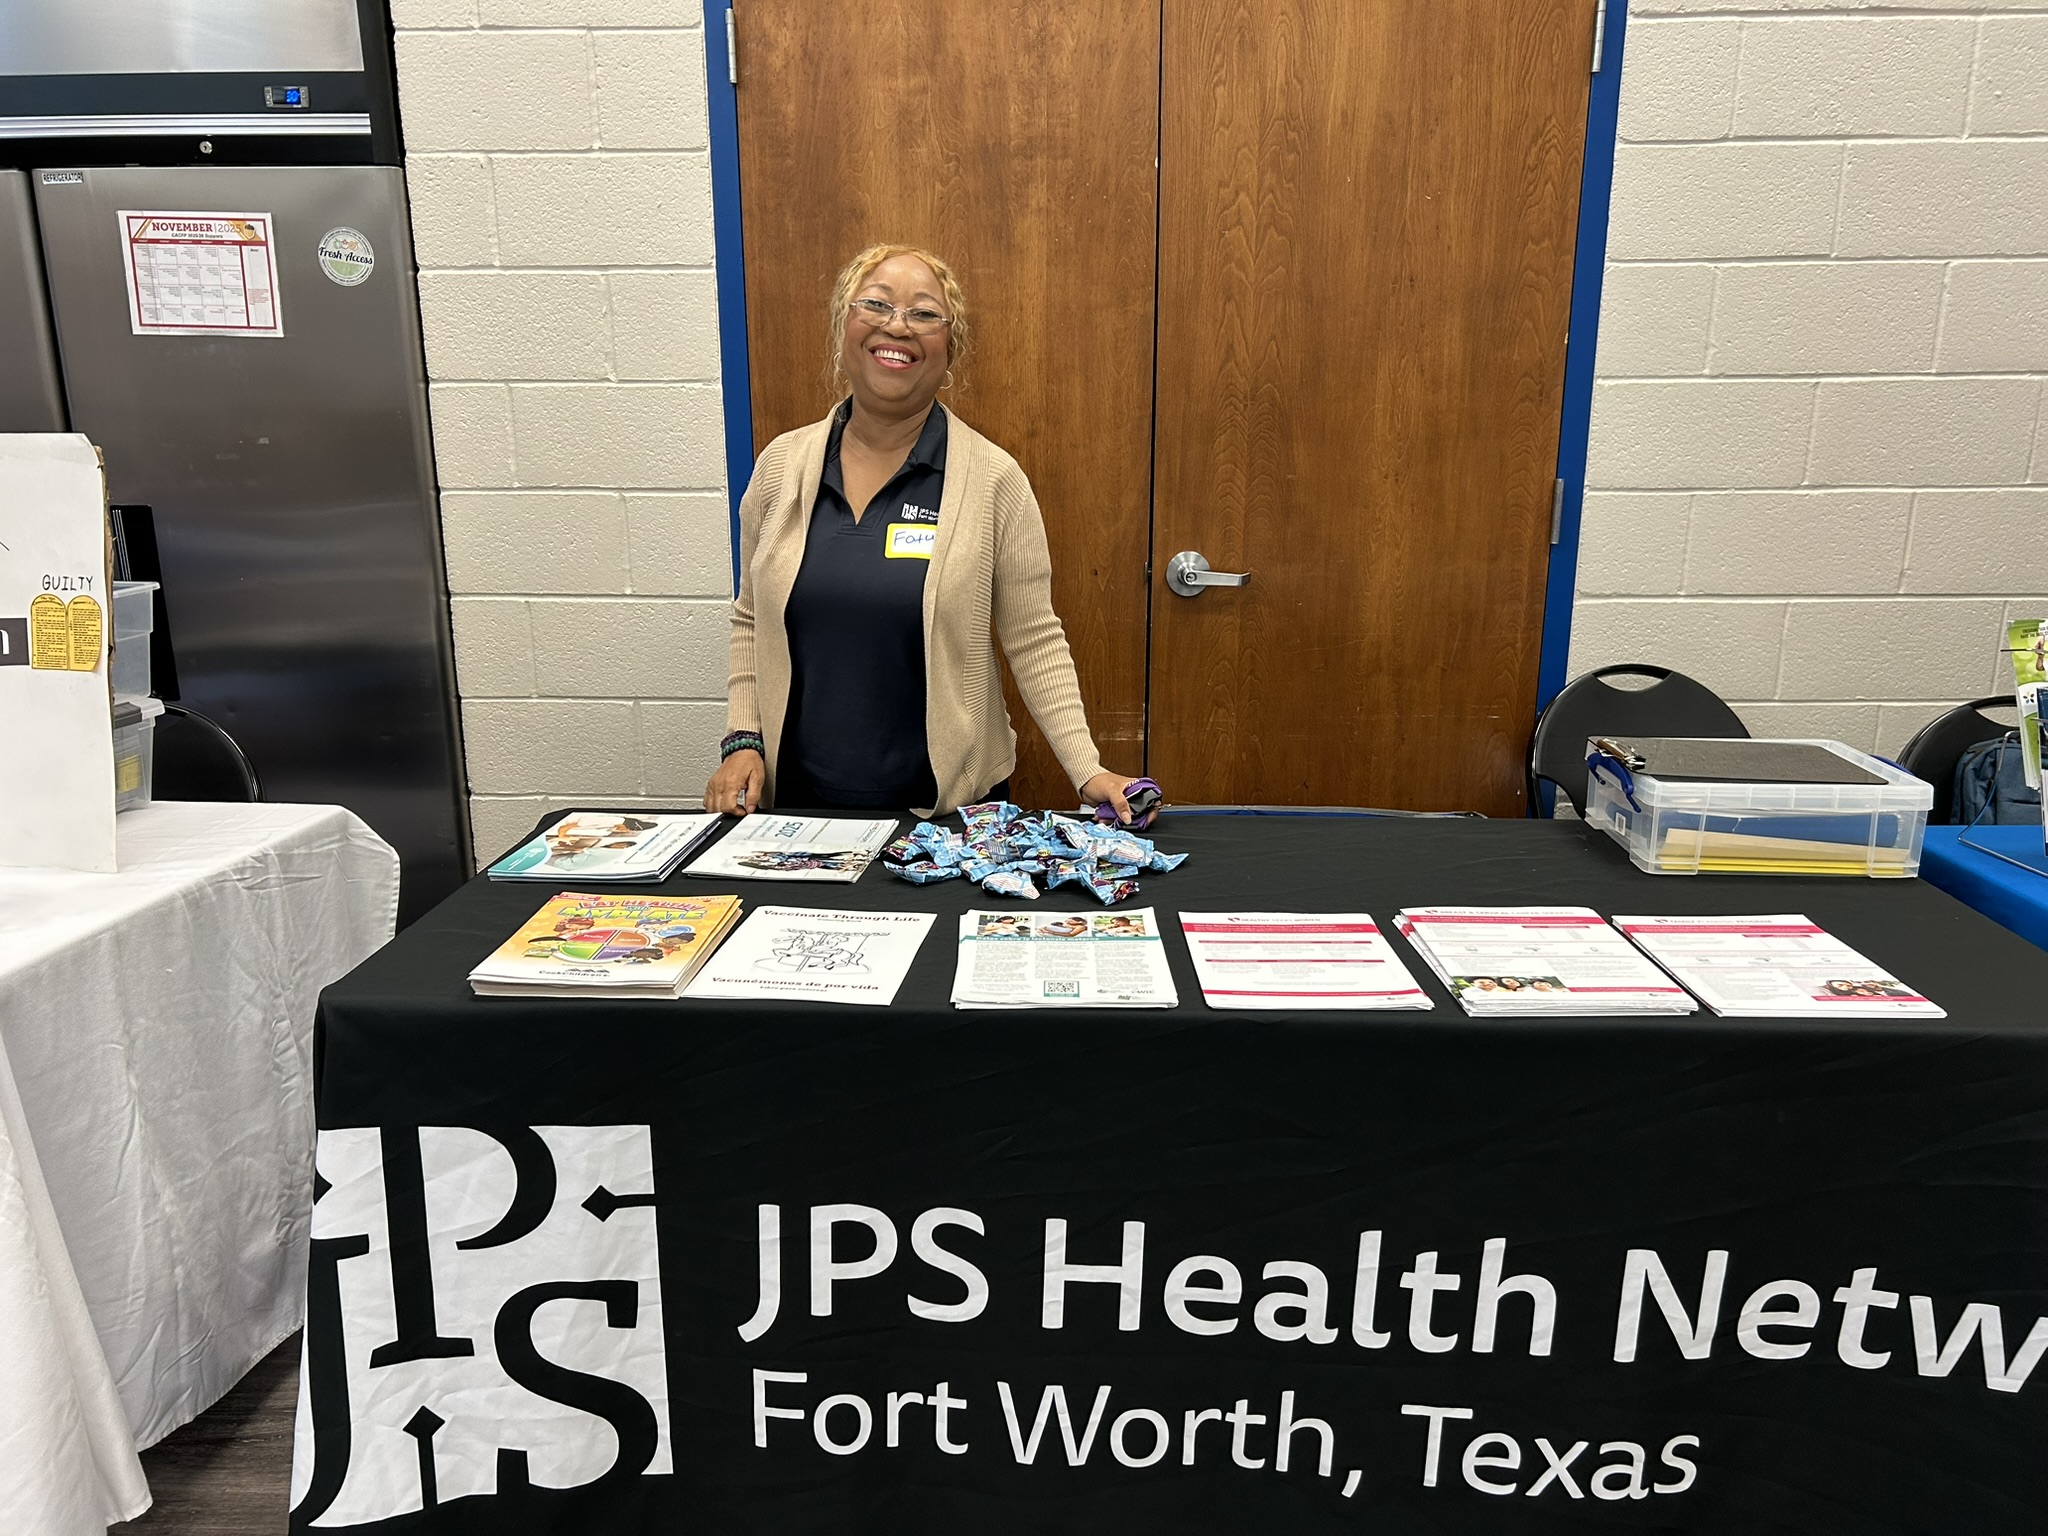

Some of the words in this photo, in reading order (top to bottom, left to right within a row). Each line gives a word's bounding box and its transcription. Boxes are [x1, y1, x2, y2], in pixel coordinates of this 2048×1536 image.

[43, 172, 83, 182] REFRIGERATOR
[152, 222, 213, 233] NOVEMBER
[217, 223, 242, 233] 2025
[319, 246, 342, 260] Fresh
[344, 251, 373, 265] Access
[42, 574, 94, 591] GUILTY
[775, 821, 804, 838] 2025
[578, 900, 619, 909] EAT
[620, 899, 706, 912] HEALTHY
[557, 906, 708, 920] MYPLATE
[763, 910, 829, 919] Vaccinate
[832, 913, 890, 922] Through
[712, 976, 803, 986] Vacunémonos
[738, 1204, 988, 1342] JPS
[1042, 1219, 1556, 1356] Health
[1614, 1249, 2048, 1392] Netw
[753, 1369, 968, 1455] Fort
[997, 1382, 1362, 1497] Worth,
[1401, 1405, 1699, 1500] Texas
